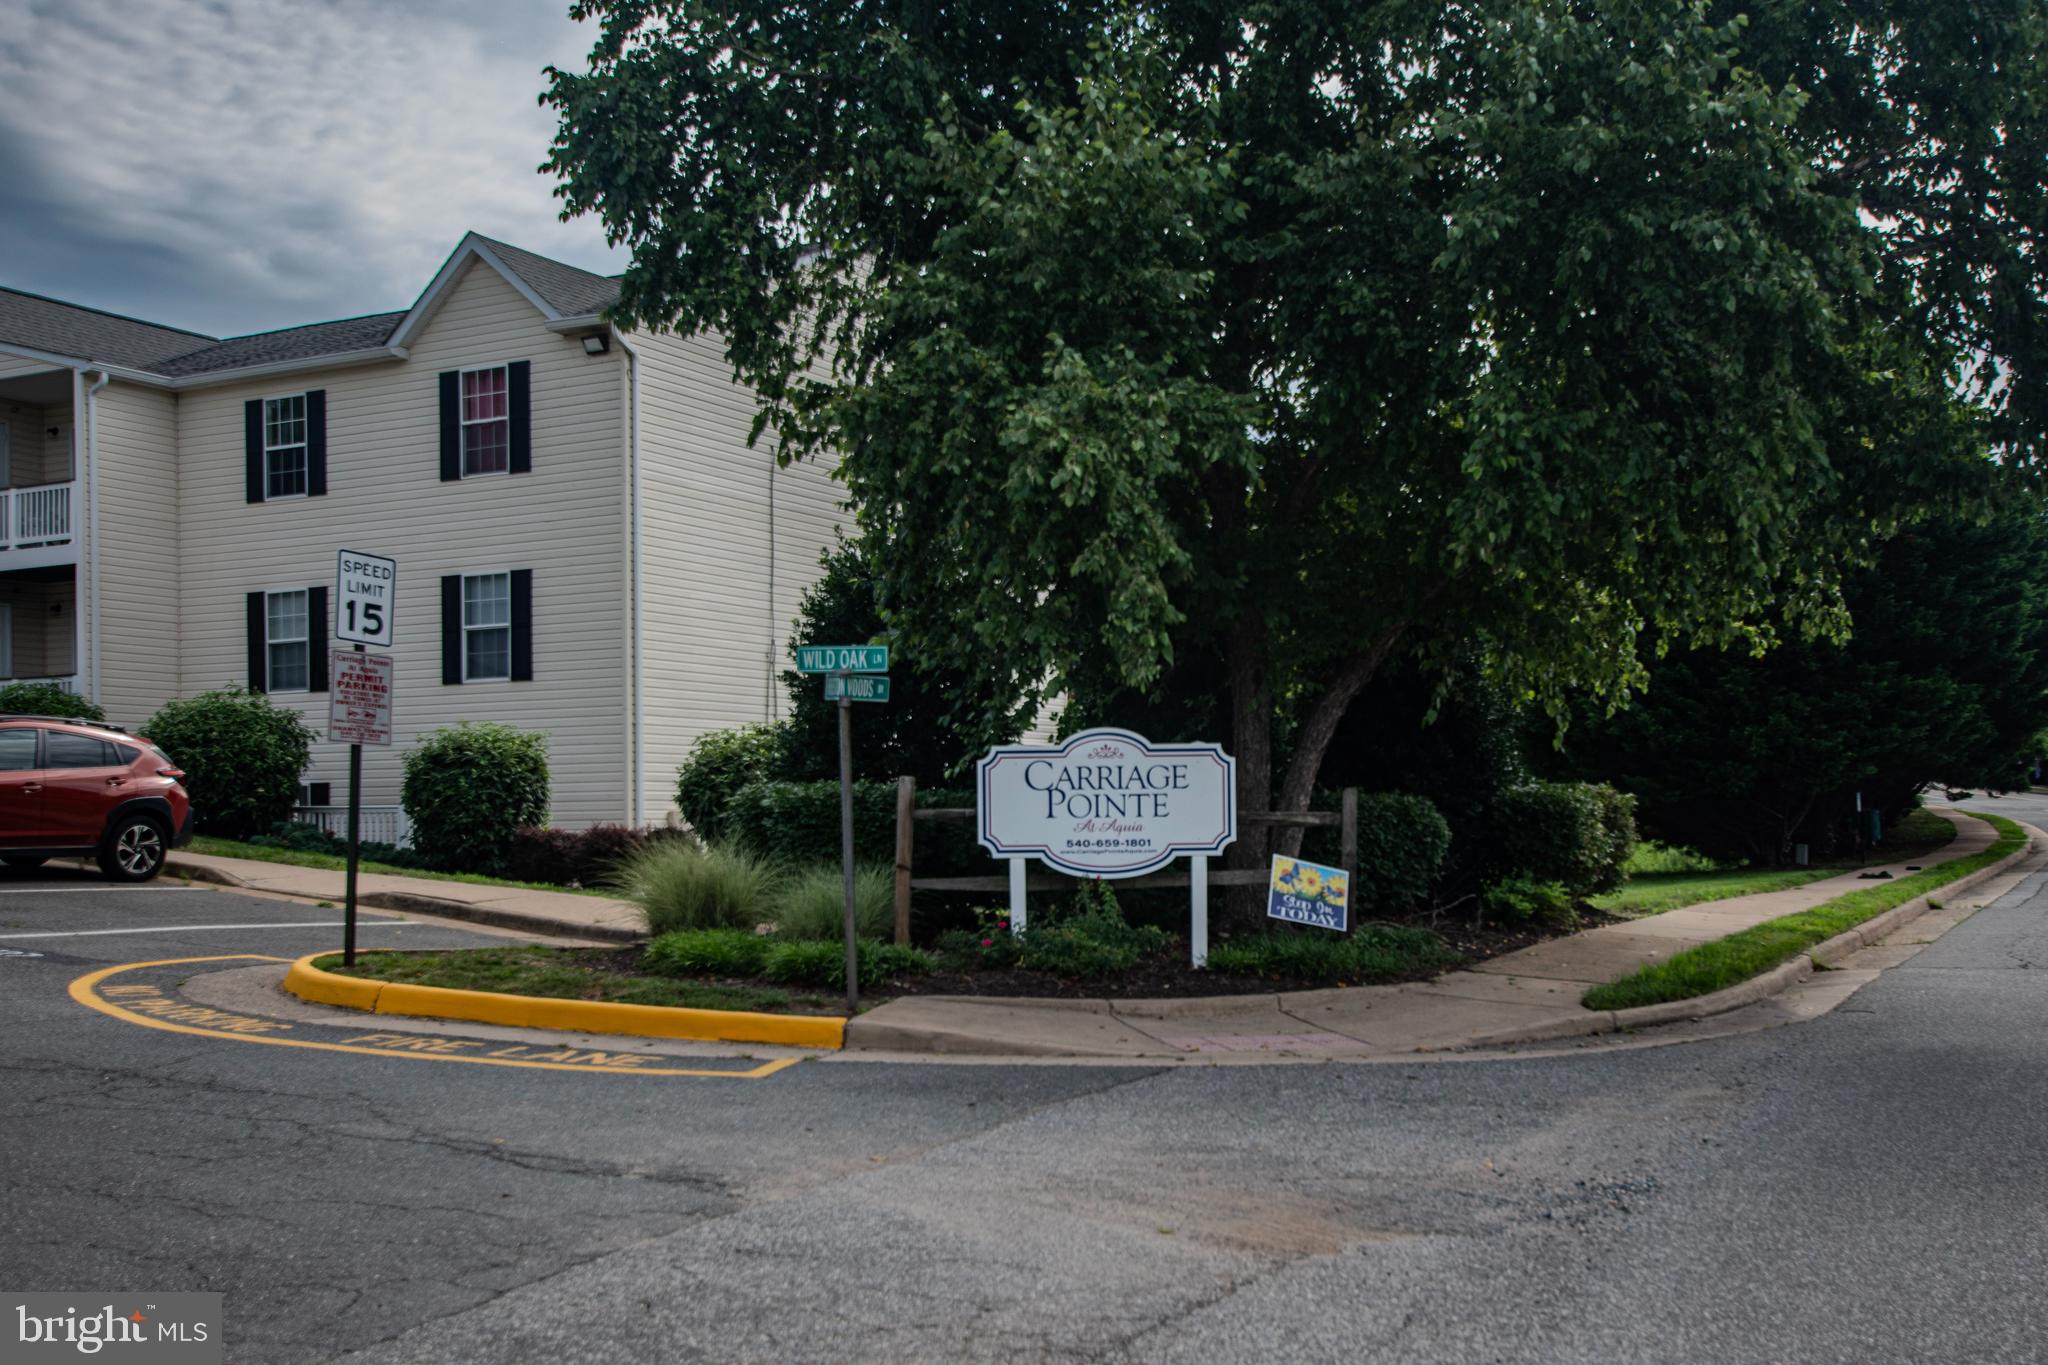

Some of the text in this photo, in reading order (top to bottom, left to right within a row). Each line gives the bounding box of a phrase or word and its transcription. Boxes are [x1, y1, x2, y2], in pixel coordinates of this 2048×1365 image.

[343, 560, 392, 580] SPEED
[347, 580, 385, 598] LIMIT
[346, 600, 384, 636] 15
[803, 649, 883, 669] WILD OAK LN
[336, 680, 389, 693] PARKING
[340, 672, 385, 684] PERMIT
[847, 678, 874, 698] WOODS
[1024, 760, 1190, 792] CARRIAGE
[1045, 788, 1170, 819] POINTE
[1073, 818, 1144, 836] At Aquia
[1066, 839, 1152, 848] 540-659-1801
[1276, 905, 1338, 927] TODAY
[341, 1034, 666, 1067] FIRE LANE
